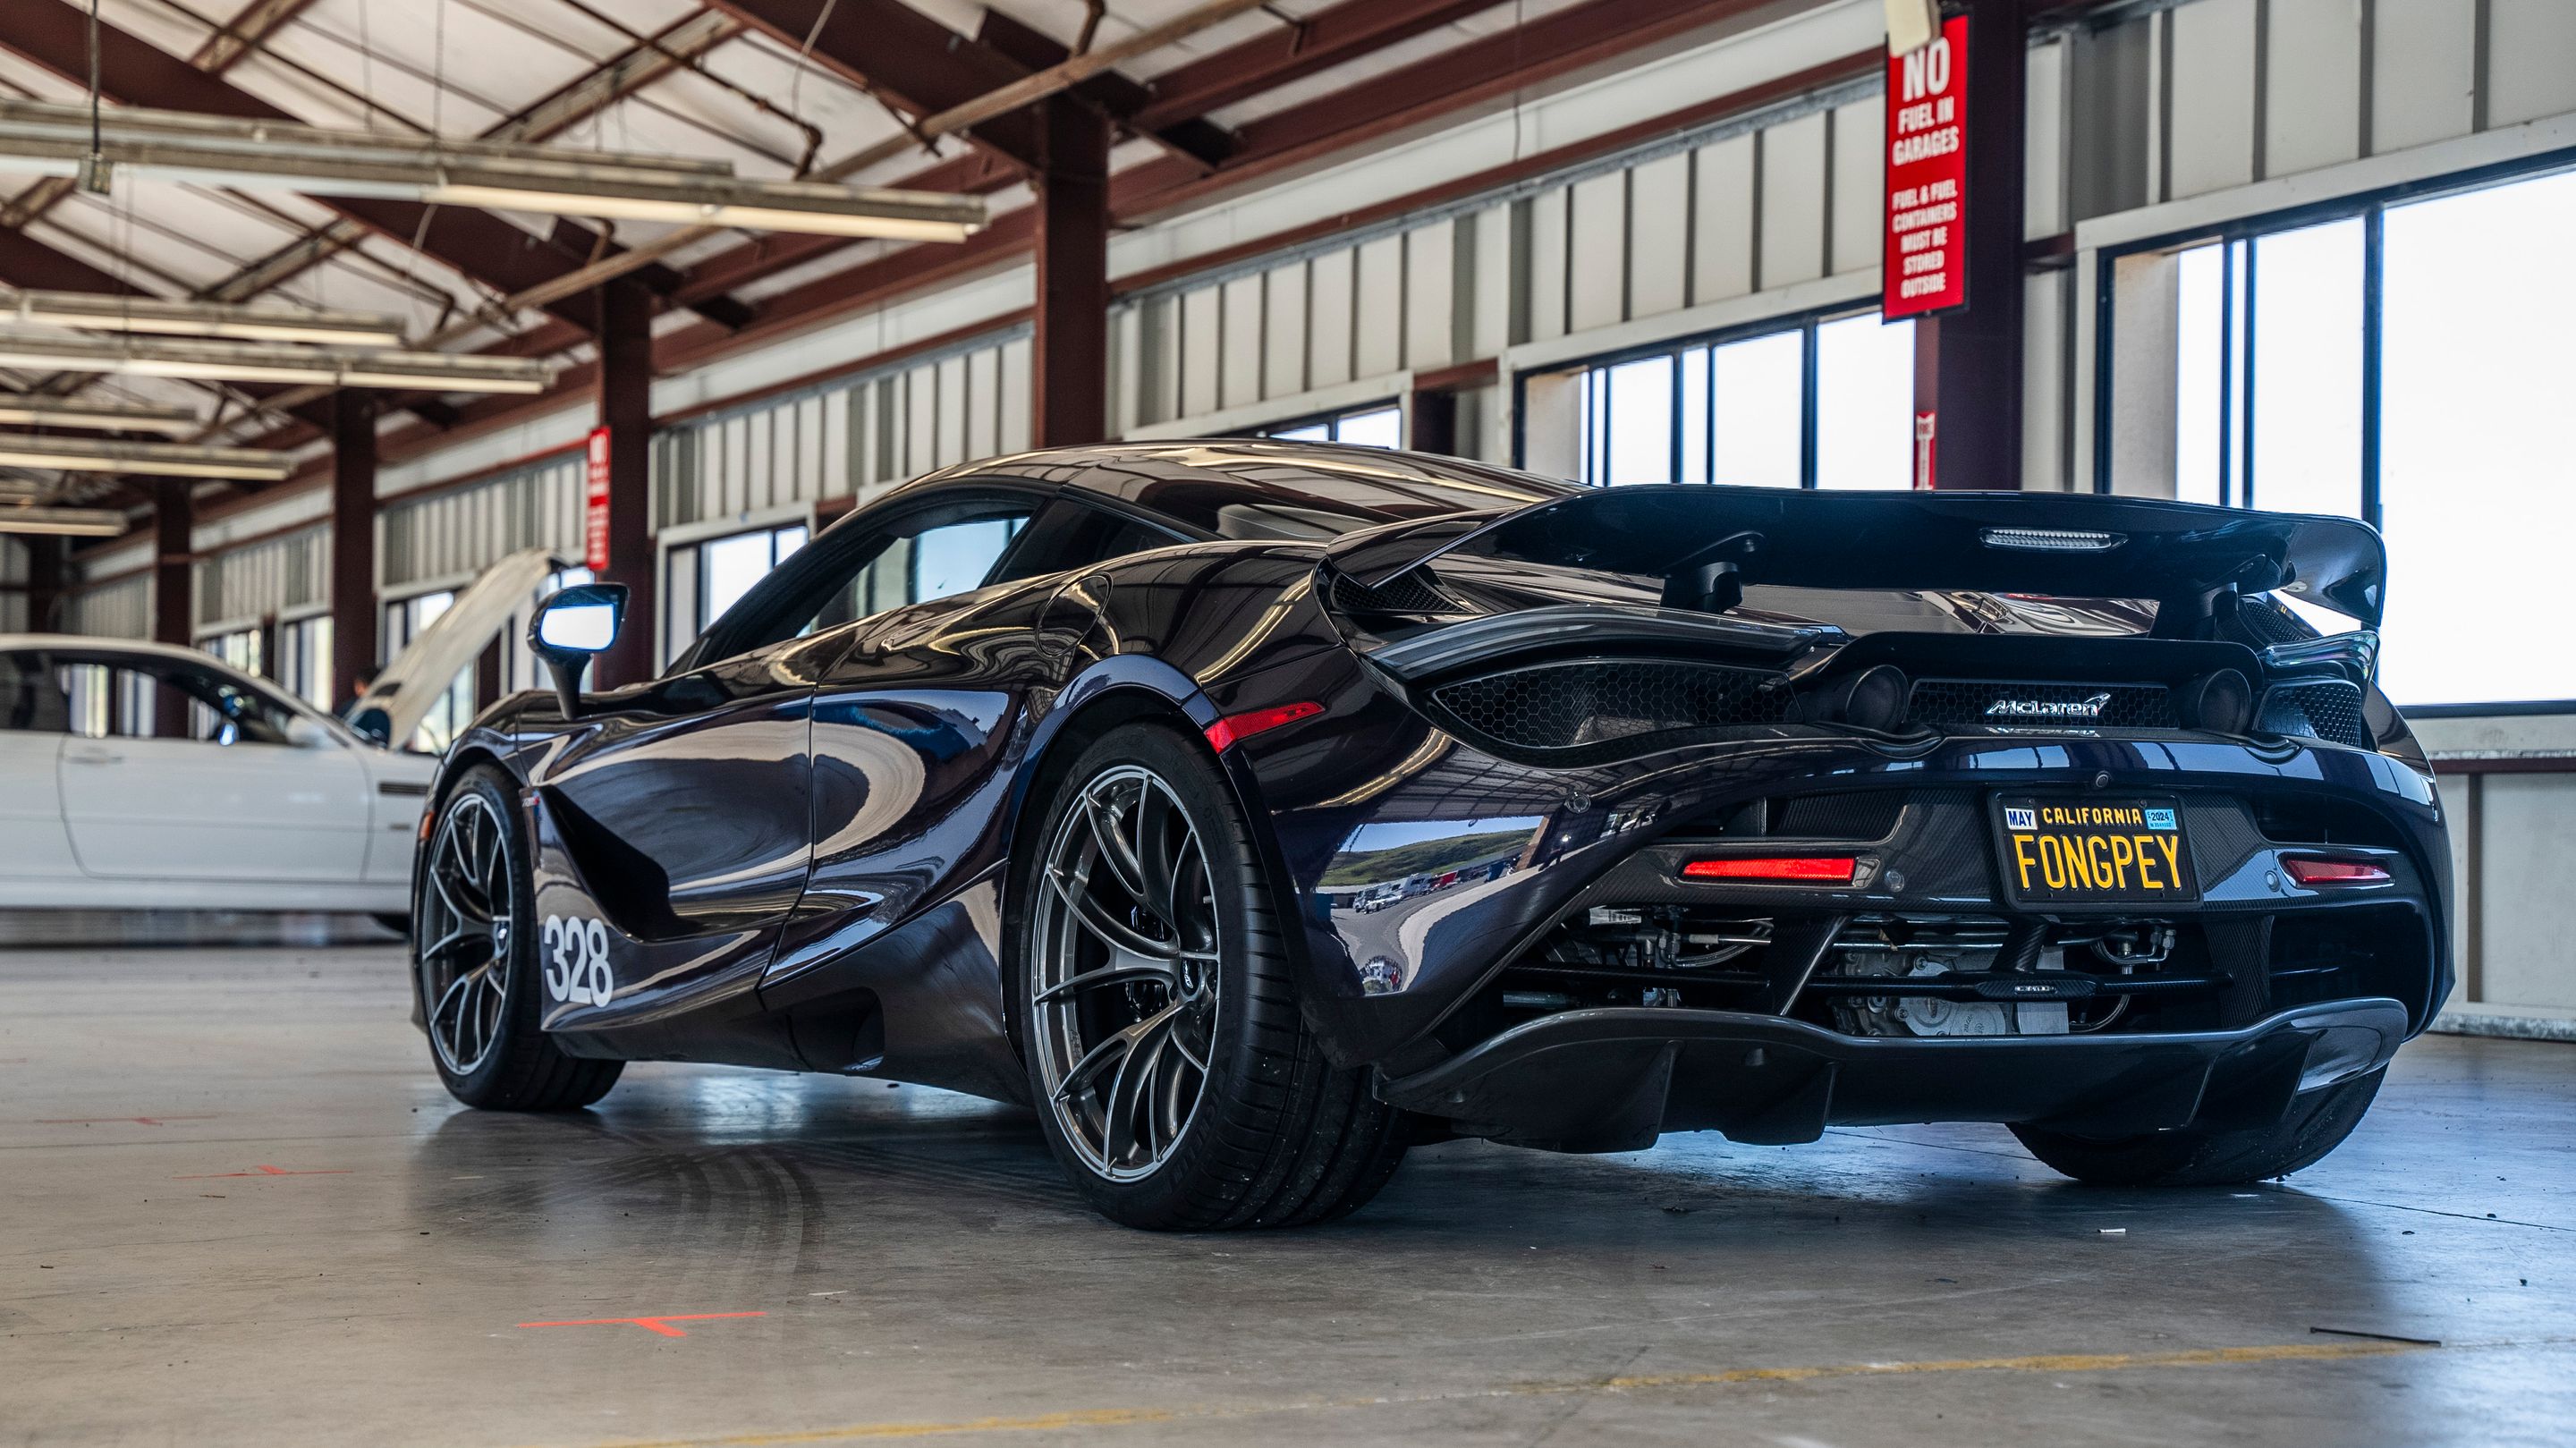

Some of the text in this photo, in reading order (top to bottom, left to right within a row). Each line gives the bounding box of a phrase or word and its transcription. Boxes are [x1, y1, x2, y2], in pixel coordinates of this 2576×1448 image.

[1902, 37, 1951, 102] NO
[1897, 96, 1954, 134] FUEL IN
[1892, 125, 1960, 166] GARAGES
[1892, 178, 1958, 211] FUEL & FUEL
[1892, 201, 1957, 233] CONTAINERS
[1901, 226, 1948, 254] MUST BE
[1902, 250, 1945, 276] STORED
[1901, 272, 1946, 299] OUTSIDE
[1986, 699, 2099, 716] McLaren
[2008, 810, 2032, 826] MAY
[2043, 808, 2142, 824] CALIFORNIA
[2150, 812, 2170, 821] 2024
[2013, 834, 2182, 890] FONGPEY
[544, 914, 614, 1008] 328
